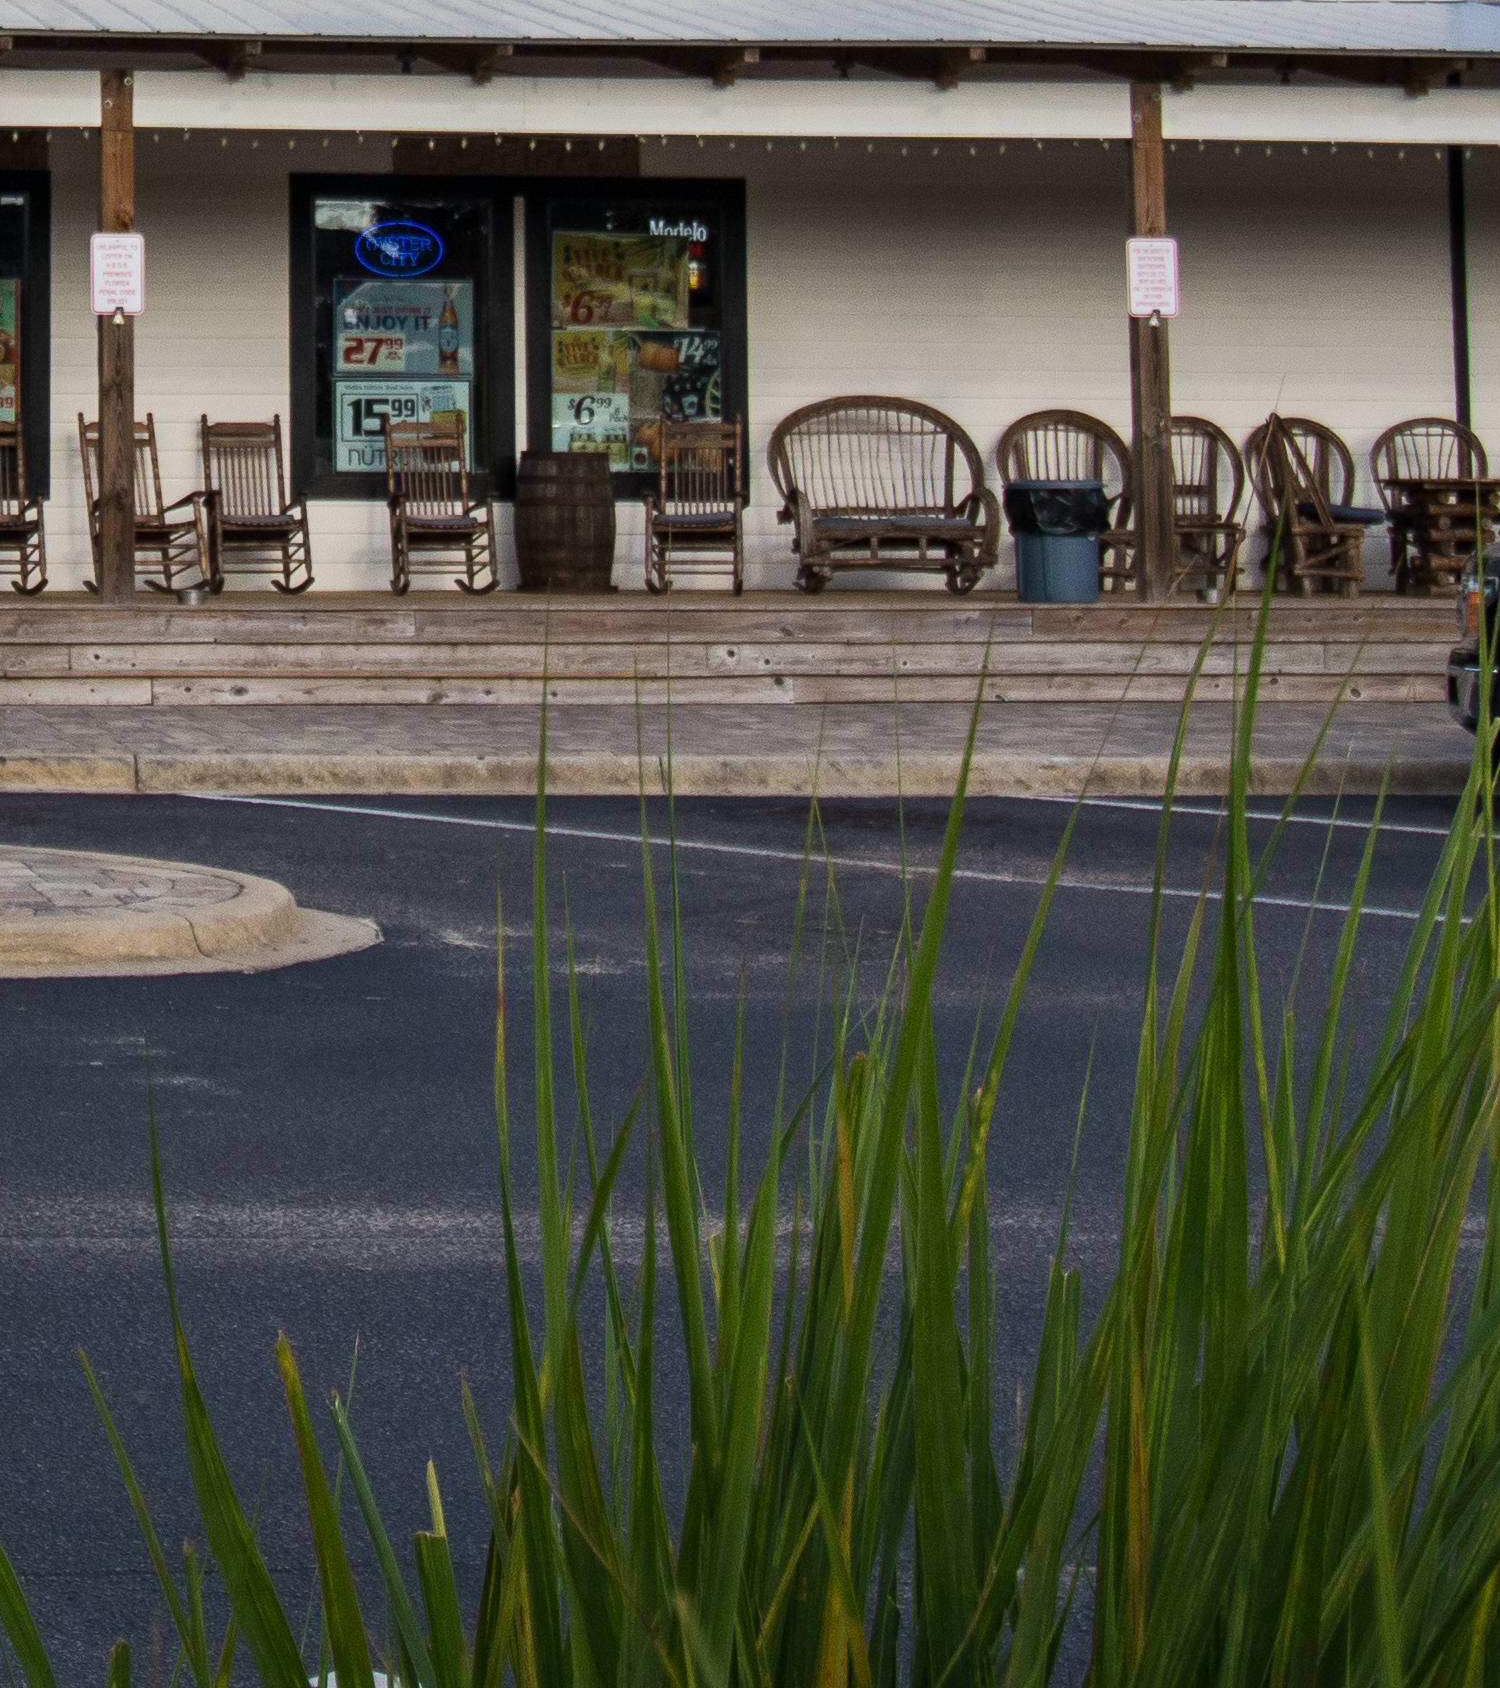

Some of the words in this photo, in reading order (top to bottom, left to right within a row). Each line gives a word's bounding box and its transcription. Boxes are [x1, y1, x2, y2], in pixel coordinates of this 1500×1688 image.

[650, 219, 707, 242] Modelo
[366, 236, 433, 252] OYSTER
[380, 252, 421, 267] CITY
[414, 316, 433, 331] IT
